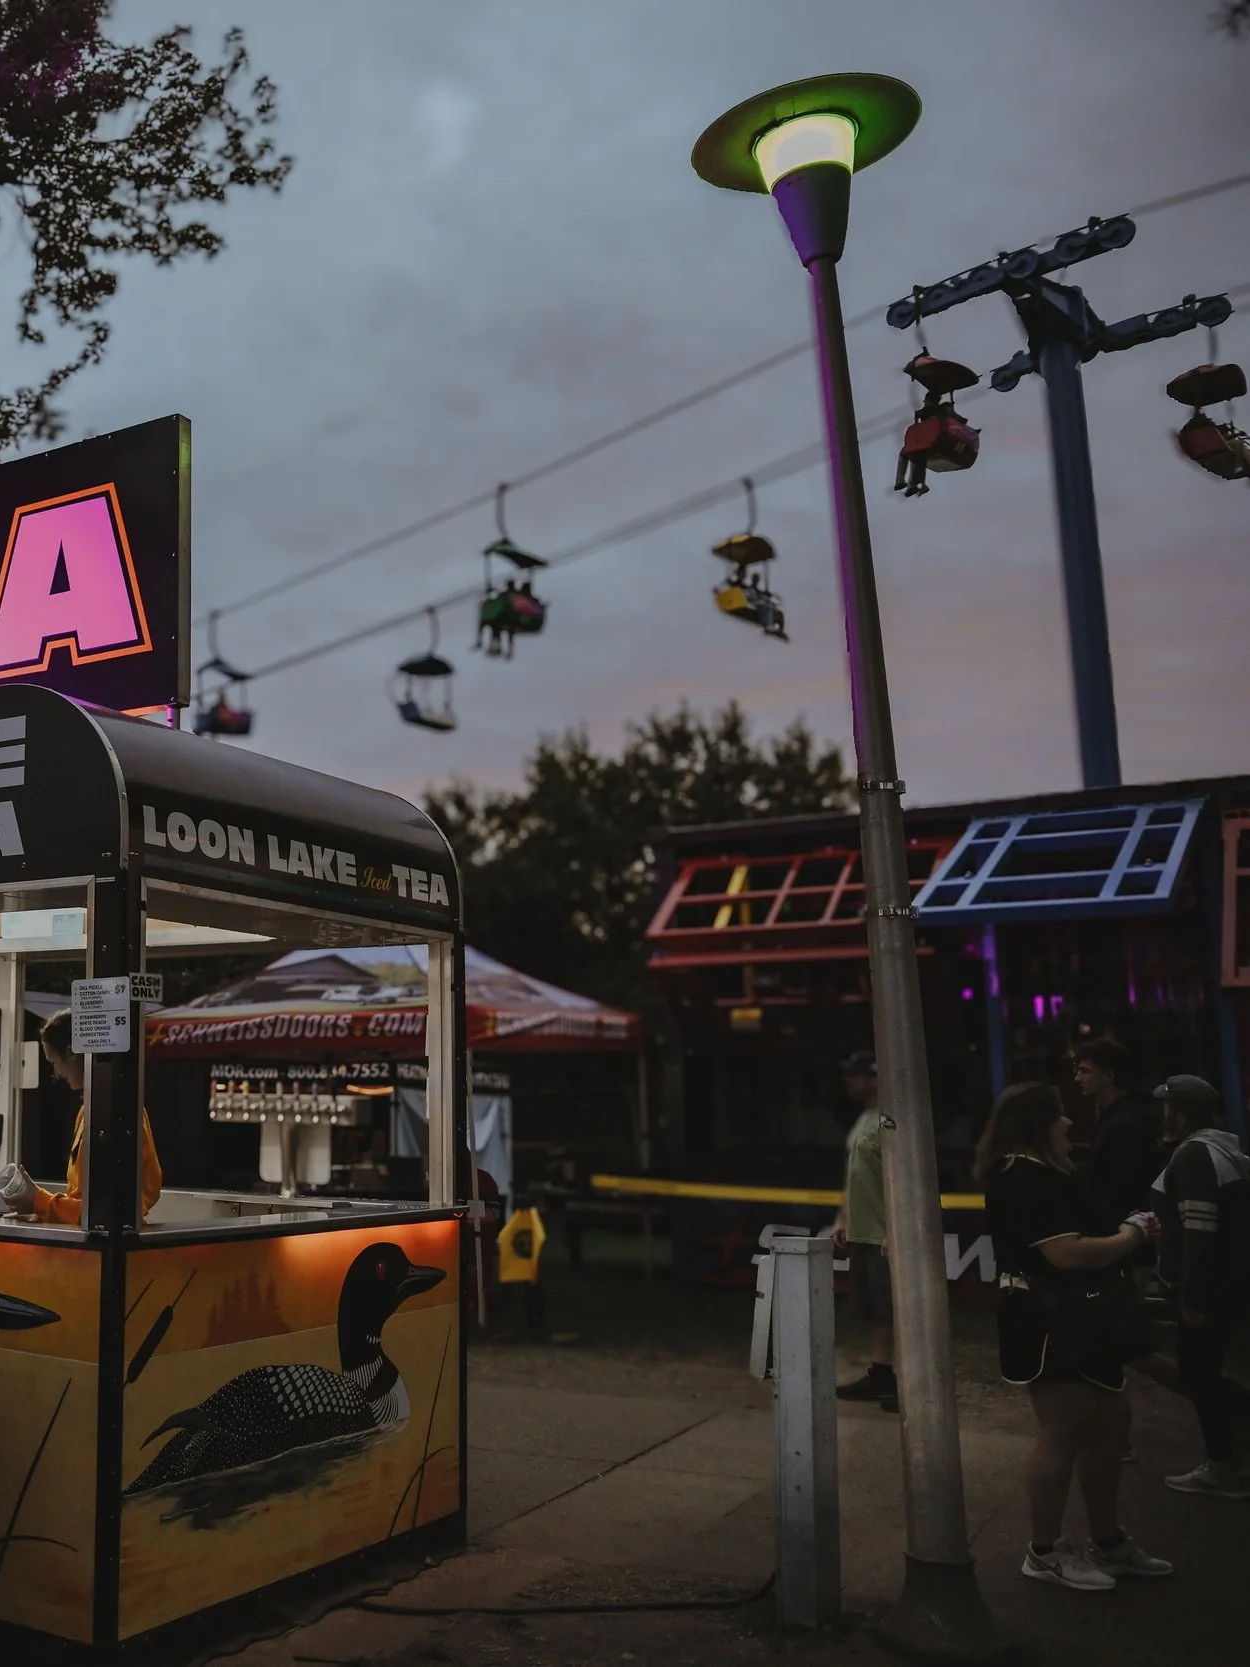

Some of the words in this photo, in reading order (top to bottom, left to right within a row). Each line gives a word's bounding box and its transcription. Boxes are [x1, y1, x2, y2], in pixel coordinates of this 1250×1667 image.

[143, 804, 255, 866] LOON
[267, 834, 357, 887] LAKE
[360, 866, 391, 892] Iced
[391, 863, 449, 906] TEA
[131, 976, 160, 987] CASH
[114, 984, 126, 995] $7
[131, 987, 160, 999] ONLY
[114, 1016, 126, 1026] $5
[318, 1223, 333, 1240] FOOD
